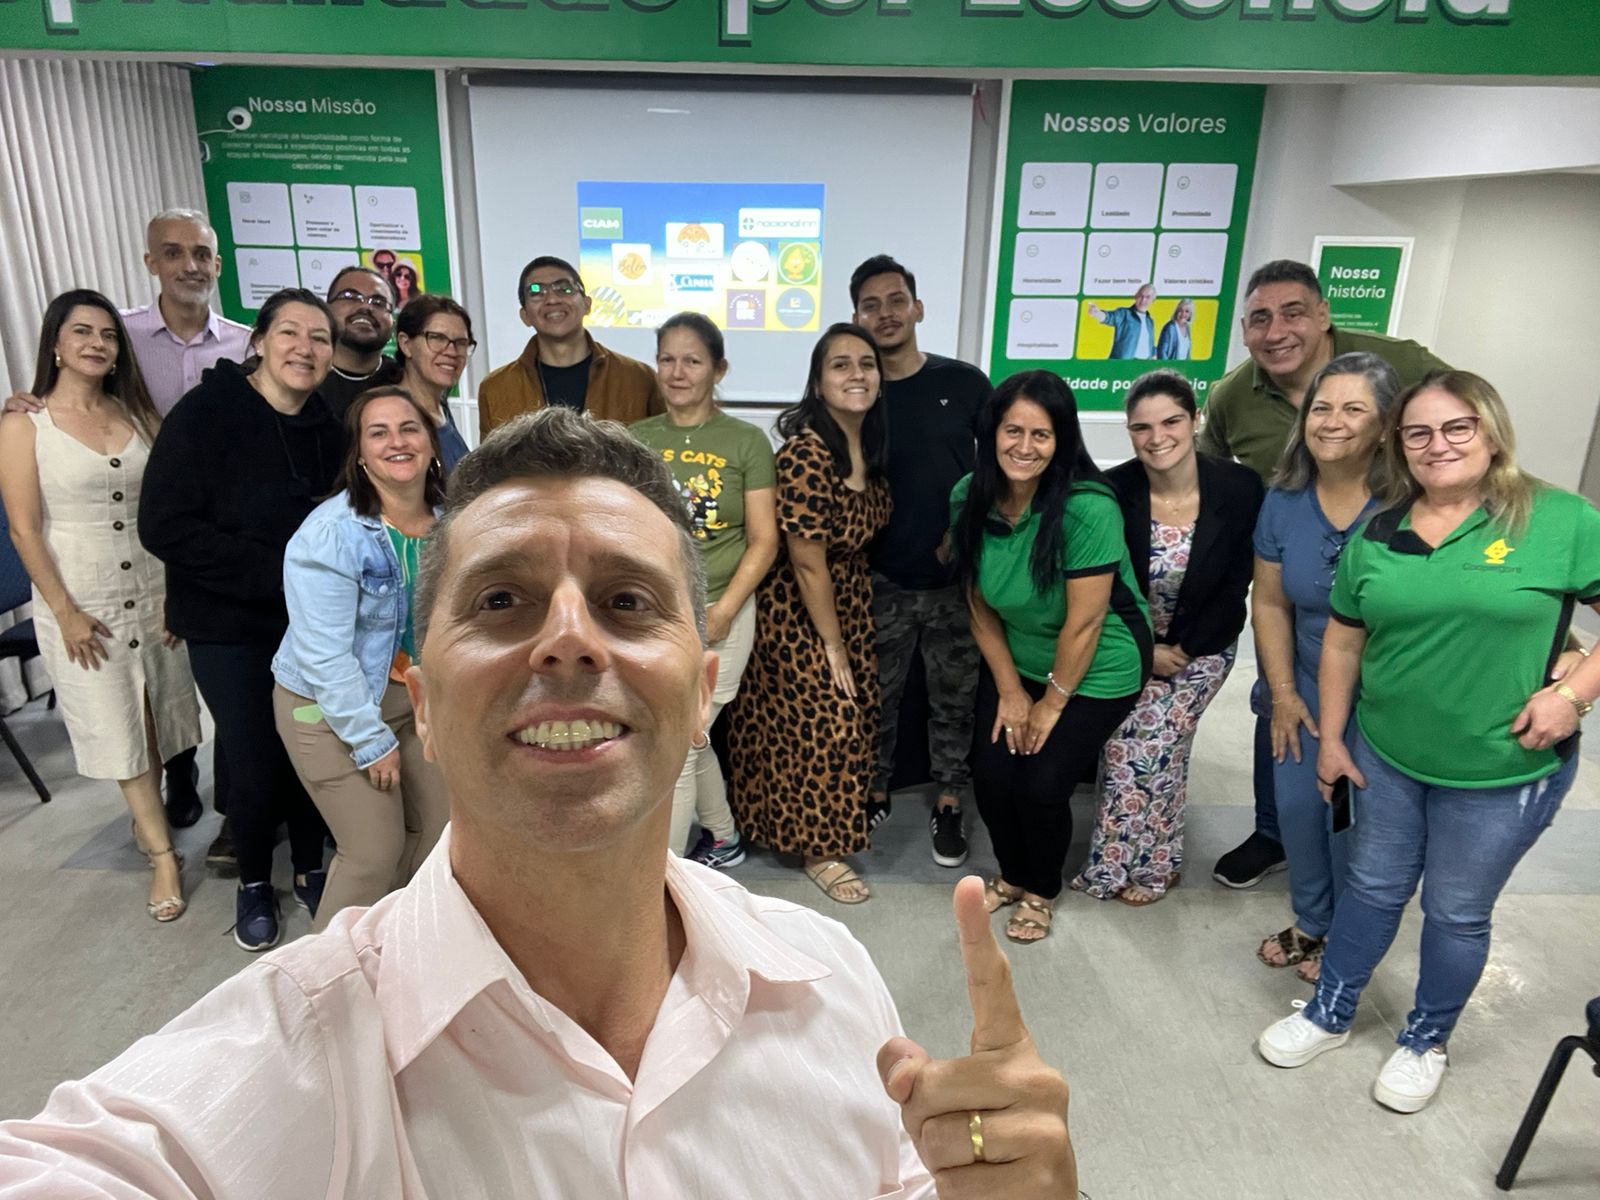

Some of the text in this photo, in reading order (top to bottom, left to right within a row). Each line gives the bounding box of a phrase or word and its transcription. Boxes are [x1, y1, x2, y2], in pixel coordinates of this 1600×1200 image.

[249, 97, 377, 115] Nossa Missão
[1043, 113, 1227, 134] Nossos Valores
[1331, 266, 1380, 280] Nossa
[1327, 285, 1386, 299] história
[680, 450, 727, 468] CATS
